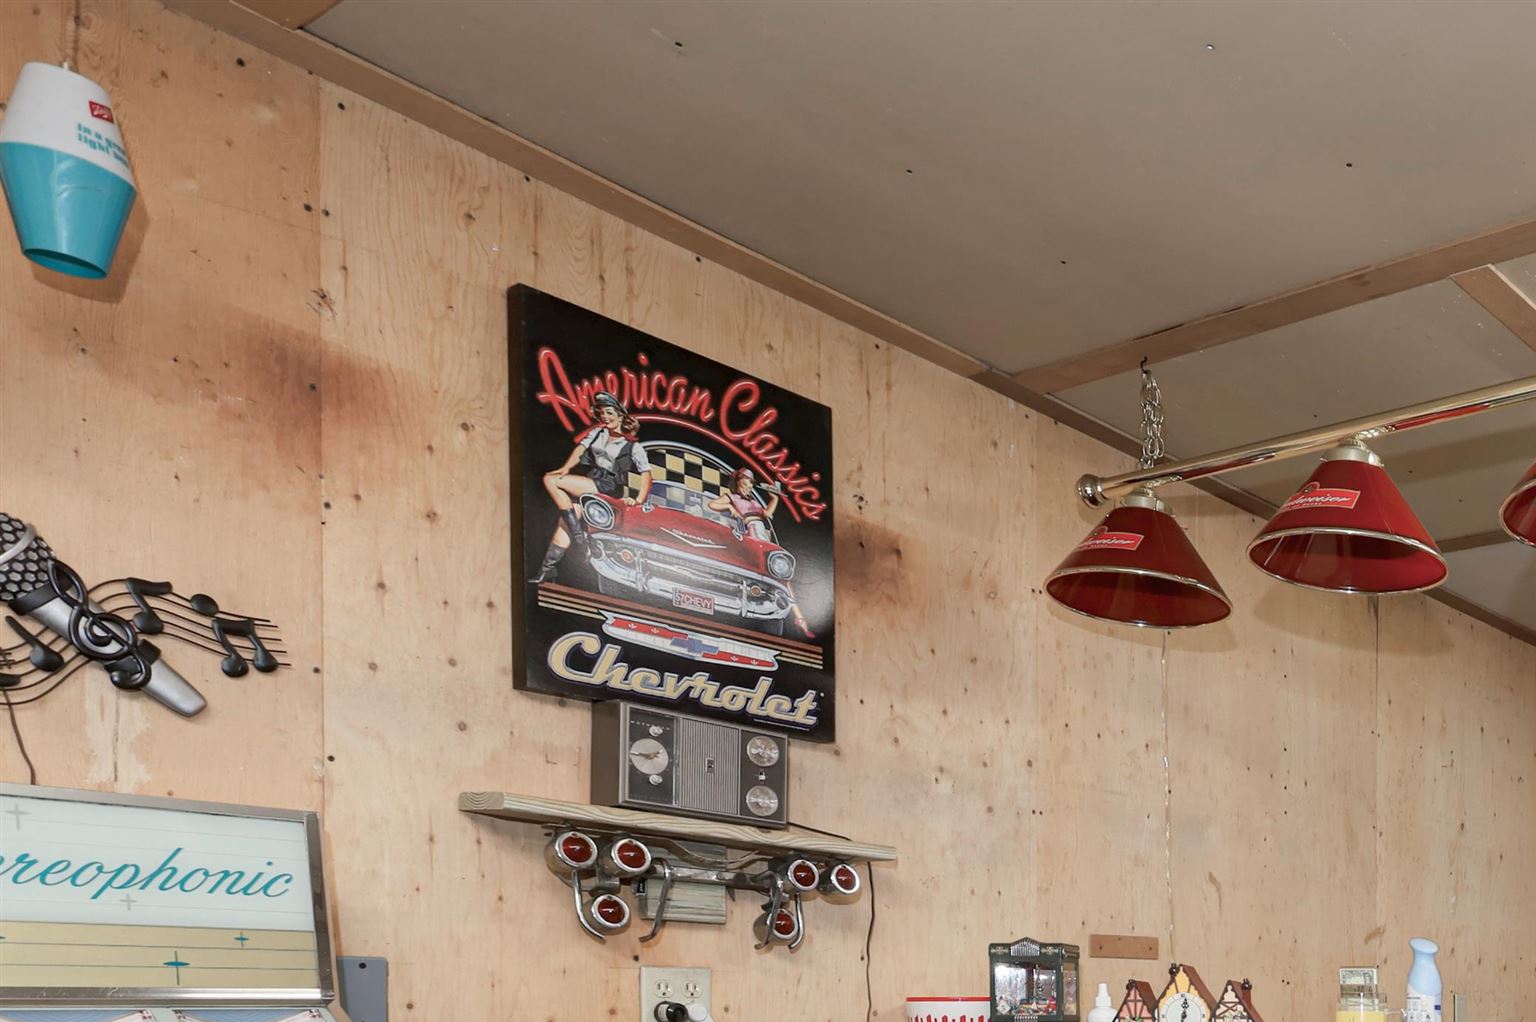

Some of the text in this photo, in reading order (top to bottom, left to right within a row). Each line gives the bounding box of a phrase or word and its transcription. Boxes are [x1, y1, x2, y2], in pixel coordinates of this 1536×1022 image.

[536, 346, 827, 520] American Classics
[1284, 493, 1351, 508] udweiser
[548, 632, 818, 724] Chevrolet
[0, 847, 293, 900] reophonic
